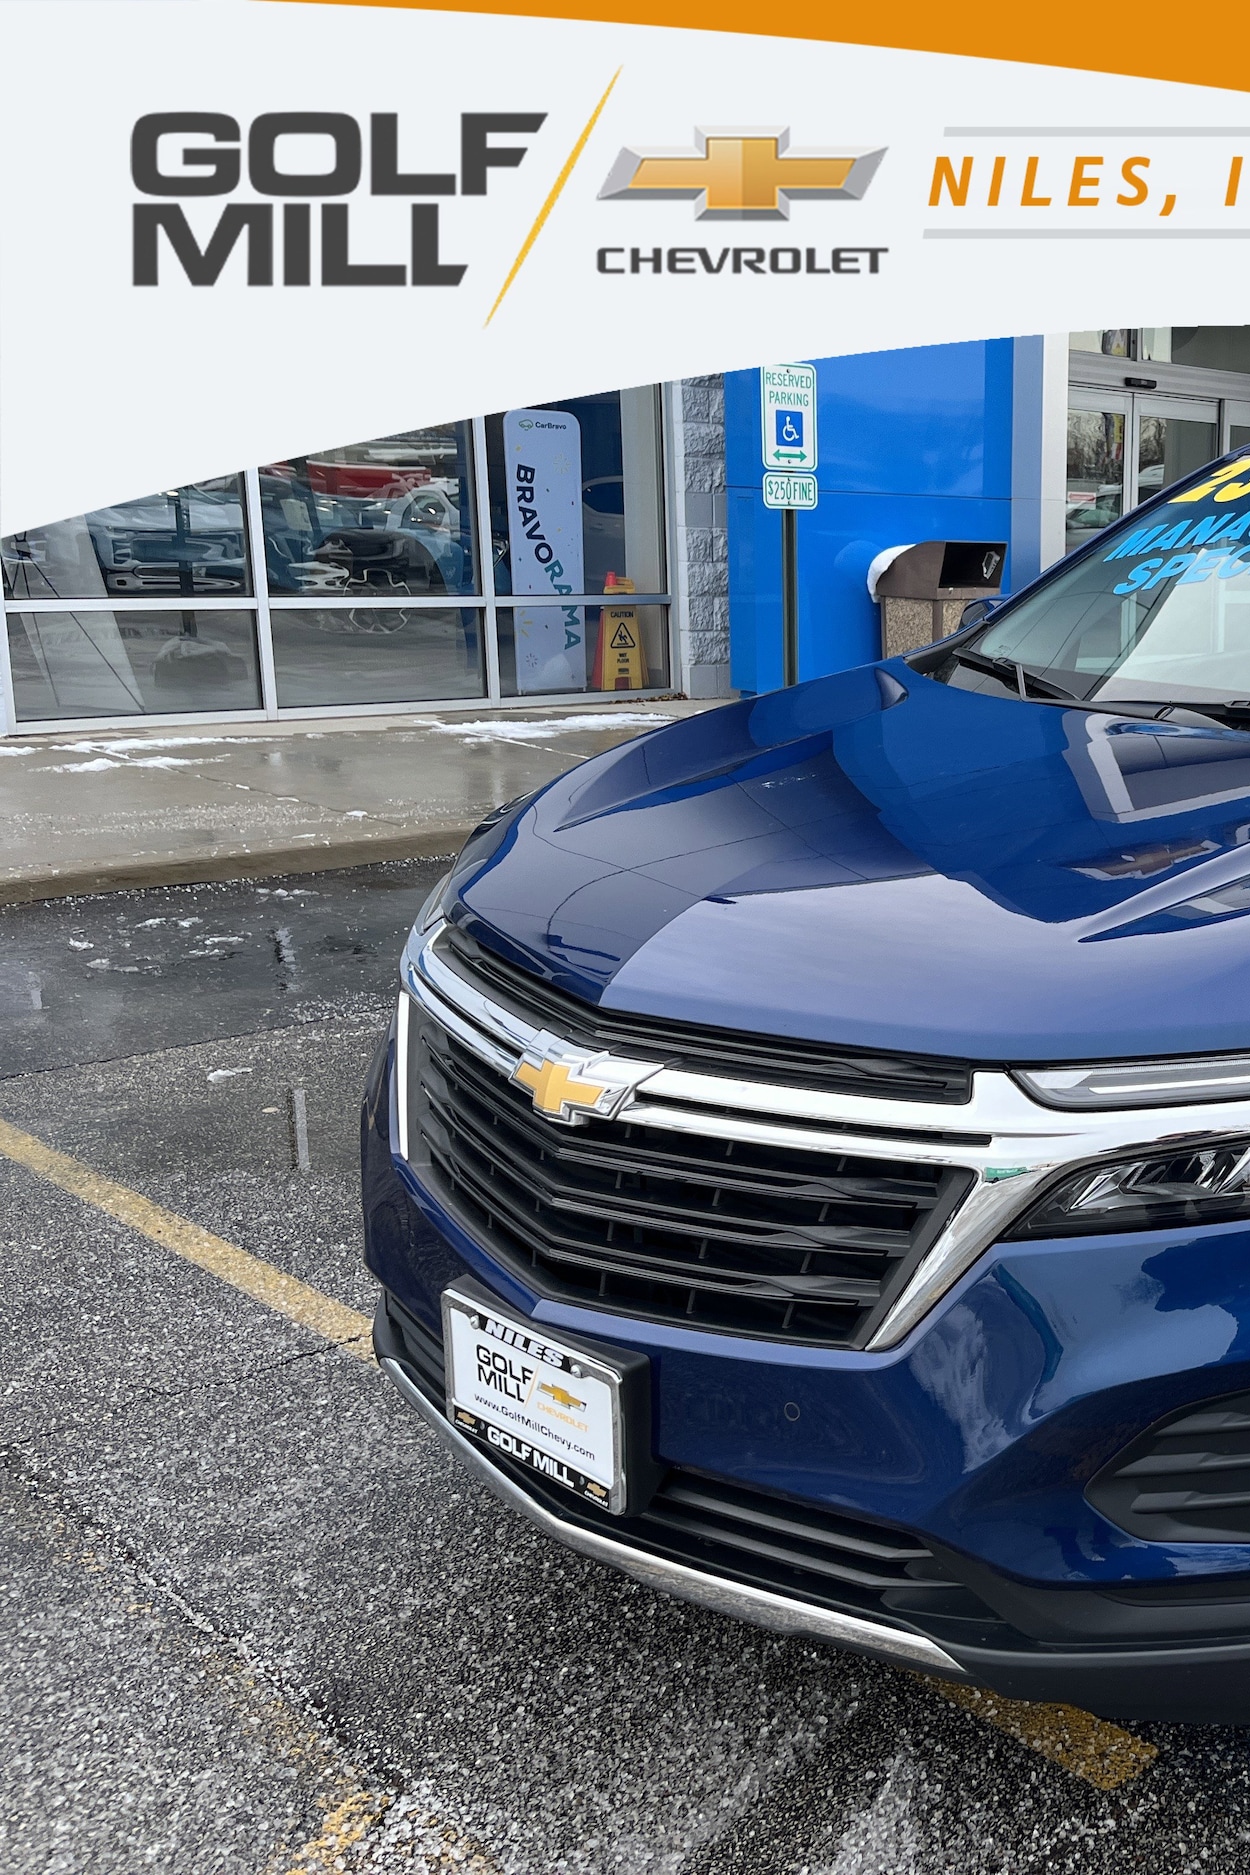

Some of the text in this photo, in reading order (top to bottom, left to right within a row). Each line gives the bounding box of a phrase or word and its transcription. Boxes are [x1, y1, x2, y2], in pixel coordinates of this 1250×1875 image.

[765, 371, 812, 389] RESERVED
[769, 391, 809, 407] PARKING
[535, 421, 567, 430] CarBravo
[768, 480, 813, 501] $250 FINE
[484, 1317, 564, 1368] NILES
[476, 1343, 534, 1386] GOLF
[477, 1363, 527, 1404] MILL
[474, 1393, 596, 1461] www.GolfMillChevy.com
[536, 1401, 590, 1433] CHEVROLET
[487, 1425, 575, 1488] GOLF MILL
